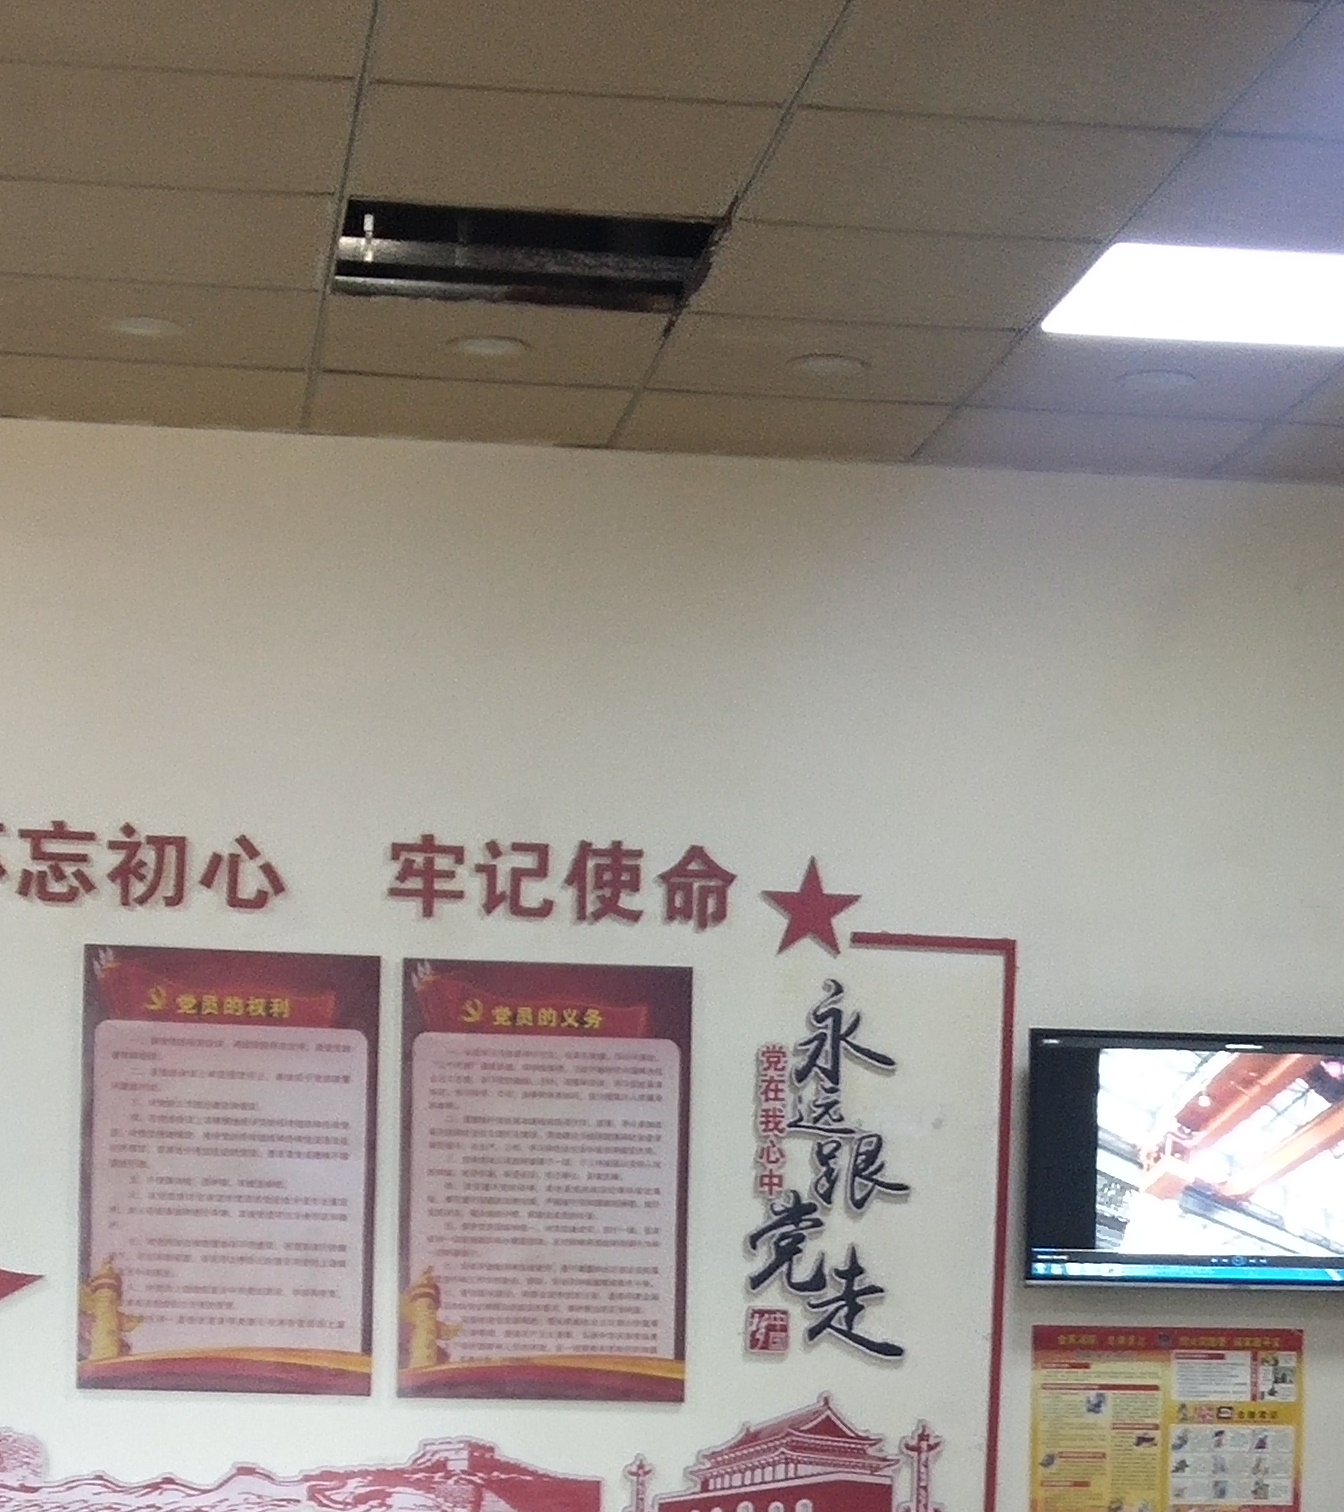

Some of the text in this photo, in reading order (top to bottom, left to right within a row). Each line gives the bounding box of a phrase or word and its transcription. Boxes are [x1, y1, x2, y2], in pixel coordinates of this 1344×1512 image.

[388, 835, 737, 930] 牢记使命
[175, 993, 292, 1019] 党员的权利
[491, 1005, 604, 1030] 党员的义务
[749, 977, 910, 1358] 永远跟党走
[758, 1045, 787, 1197] 党在我心中
